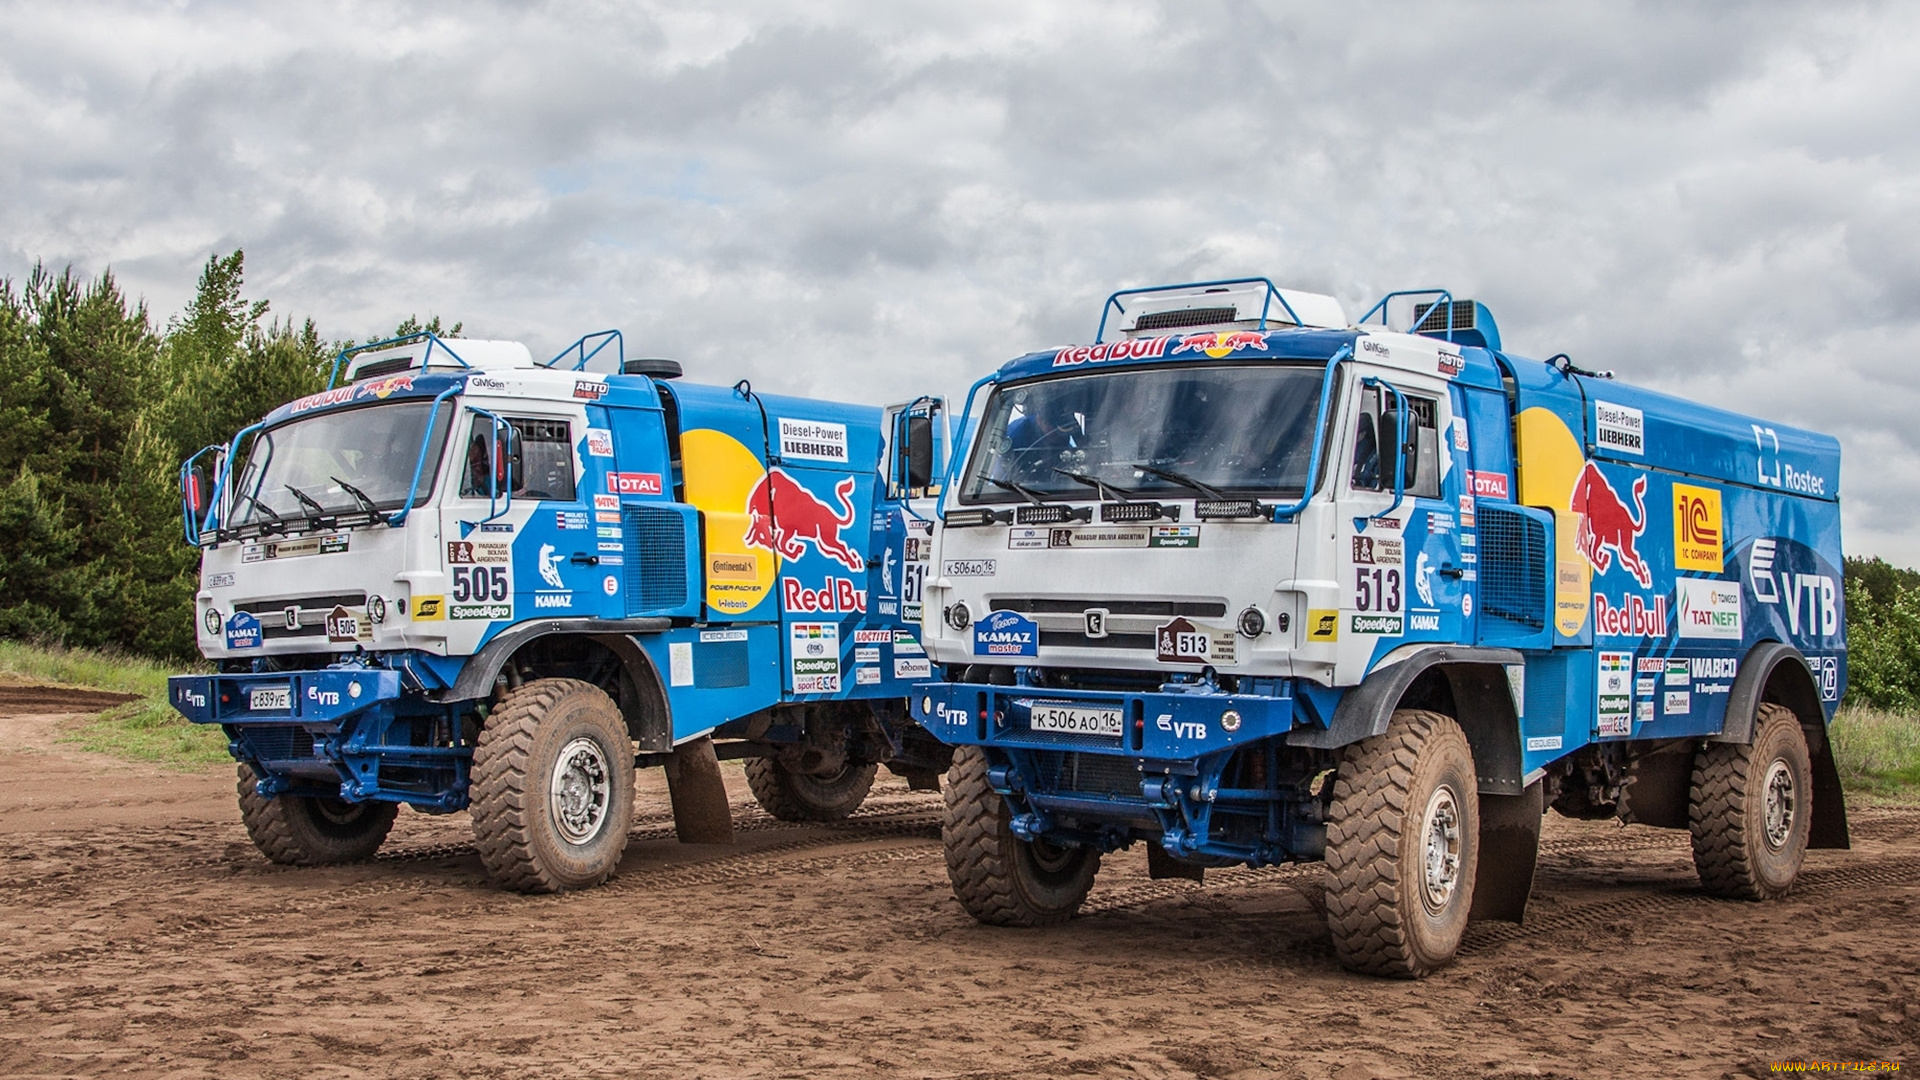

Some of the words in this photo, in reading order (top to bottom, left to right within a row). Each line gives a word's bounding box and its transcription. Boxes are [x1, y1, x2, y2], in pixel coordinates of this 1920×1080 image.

[1054, 343, 1107, 364] Red
[1108, 335, 1170, 359] Bull
[472, 378, 505, 388] GMGen
[576, 381, 608, 393] АВТО
[1598, 406, 1641, 428] Diesel-Power
[783, 423, 843, 440] Diesel-Power
[1599, 428, 1641, 449] LIEBHERR
[784, 441, 844, 457] LIEBHERR
[610, 476, 660, 491] TOTAL
[1467, 474, 1506, 495] TOTAL
[1785, 463, 1825, 495] Rostec
[1378, 539, 1401, 547] PARAGUAY
[1376, 556, 1401, 564] ARGENTINA
[1691, 549, 1718, 562] COMPANY
[713, 560, 747, 573] Continental
[453, 566, 508, 602] 505
[1356, 567, 1400, 612] 513
[535, 595, 572, 608] KAMAZ
[784, 578, 834, 611] Red
[838, 580, 867, 612] Bu
[1781, 572, 1837, 636] VTB
[452, 605, 508, 619] SpeedAgro
[1595, 595, 1631, 634] Red
[1633, 596, 1665, 635] Bull
[1691, 610, 1738, 626] TATNEFT
[339, 619, 356, 634] 505
[990, 613, 1019, 631] Team
[1354, 617, 1400, 633] SpeedAgro
[1411, 615, 1439, 631] KAMAZ
[228, 628, 259, 638] KAMAZ
[702, 631, 746, 641] ICEQUEEN
[856, 631, 889, 642] LOCTITE
[978, 632, 1032, 643] KAMAZ
[989, 643, 1022, 654] master
[1181, 636, 1207, 653] 513
[796, 660, 836, 673] SpeedAgro
[1638, 659, 1663, 671] LOCTITE
[1692, 658, 1737, 678] WABCO
[797, 681, 815, 691] sport
[191, 694, 205, 707] VTB
[318, 691, 340, 705] VTB
[1600, 698, 1629, 711] SpeedAgro
[945, 709, 968, 726] VTB
[1102, 712, 1116, 727] 16
[1174, 722, 1207, 740] VTB
